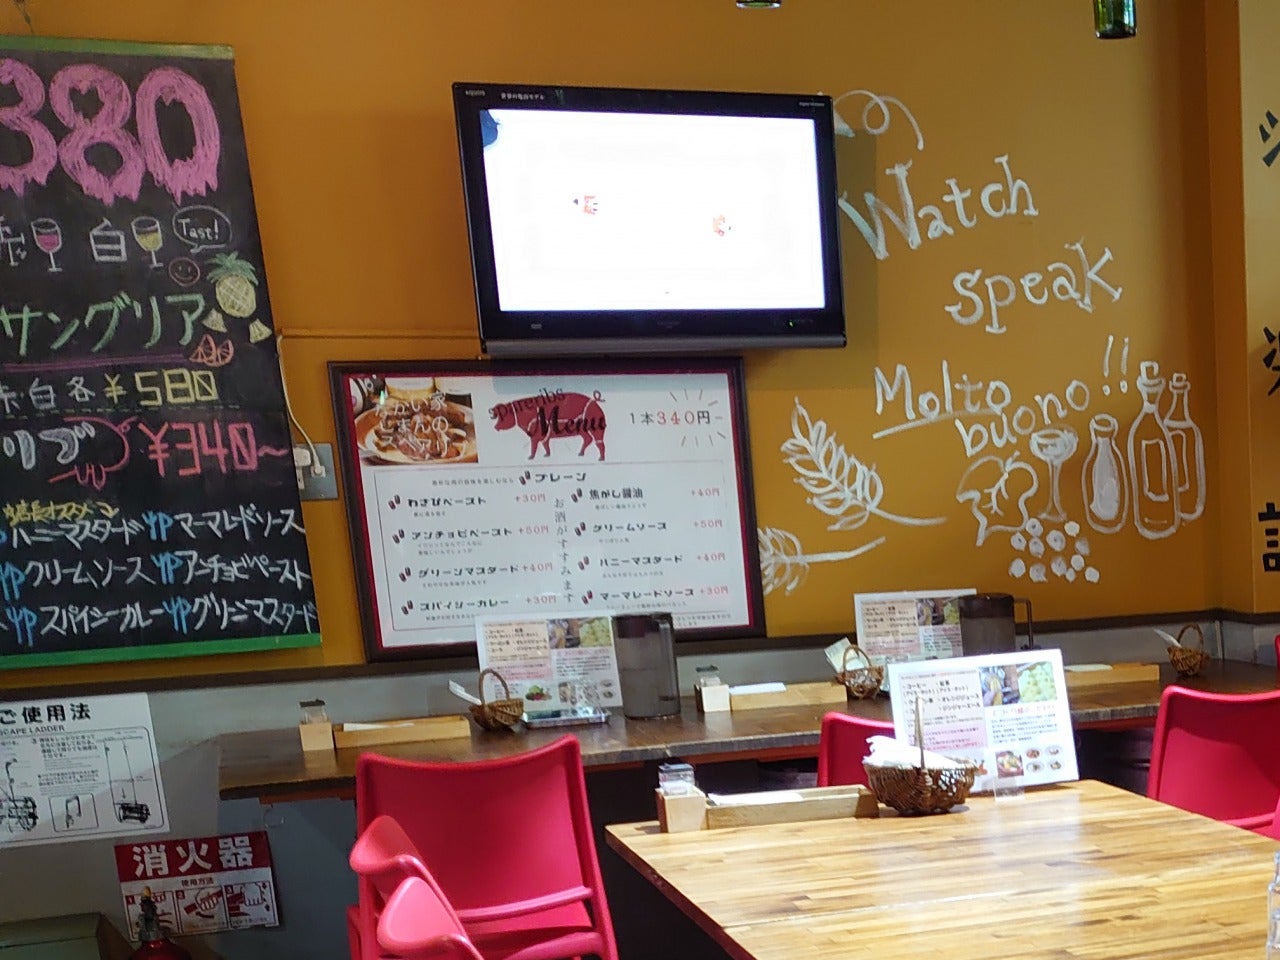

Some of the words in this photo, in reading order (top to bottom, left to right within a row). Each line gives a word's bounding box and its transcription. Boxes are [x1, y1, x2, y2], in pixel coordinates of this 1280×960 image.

[838, 154, 1038, 260] Watch
[90, 217, 127, 263] 白
[0, 291, 206, 357] サングリア
[874, 360, 1012, 421] Molto
[527, 405, 607, 437] Menu
[534, 472, 588, 483] プレーン
[407, 496, 488, 508] わさびペースト
[412, 528, 513, 541] アンチョビペースト
[592, 522, 668, 534] クリームソース
[600, 555, 683, 568] ハニーマスタード
[25, 557, 156, 589] クリームソース
[174, 550, 311, 590] アンチョビペースト
[419, 565, 519, 579] グリーンマスタード
[600, 588, 695, 601] マーマレードソース
[419, 598, 510, 612] スパイシーカレー
[0, 702, 91, 725] ご使用法
[132, 836, 253, 878] 消火器
[182, 877, 215, 888] 使用方法
